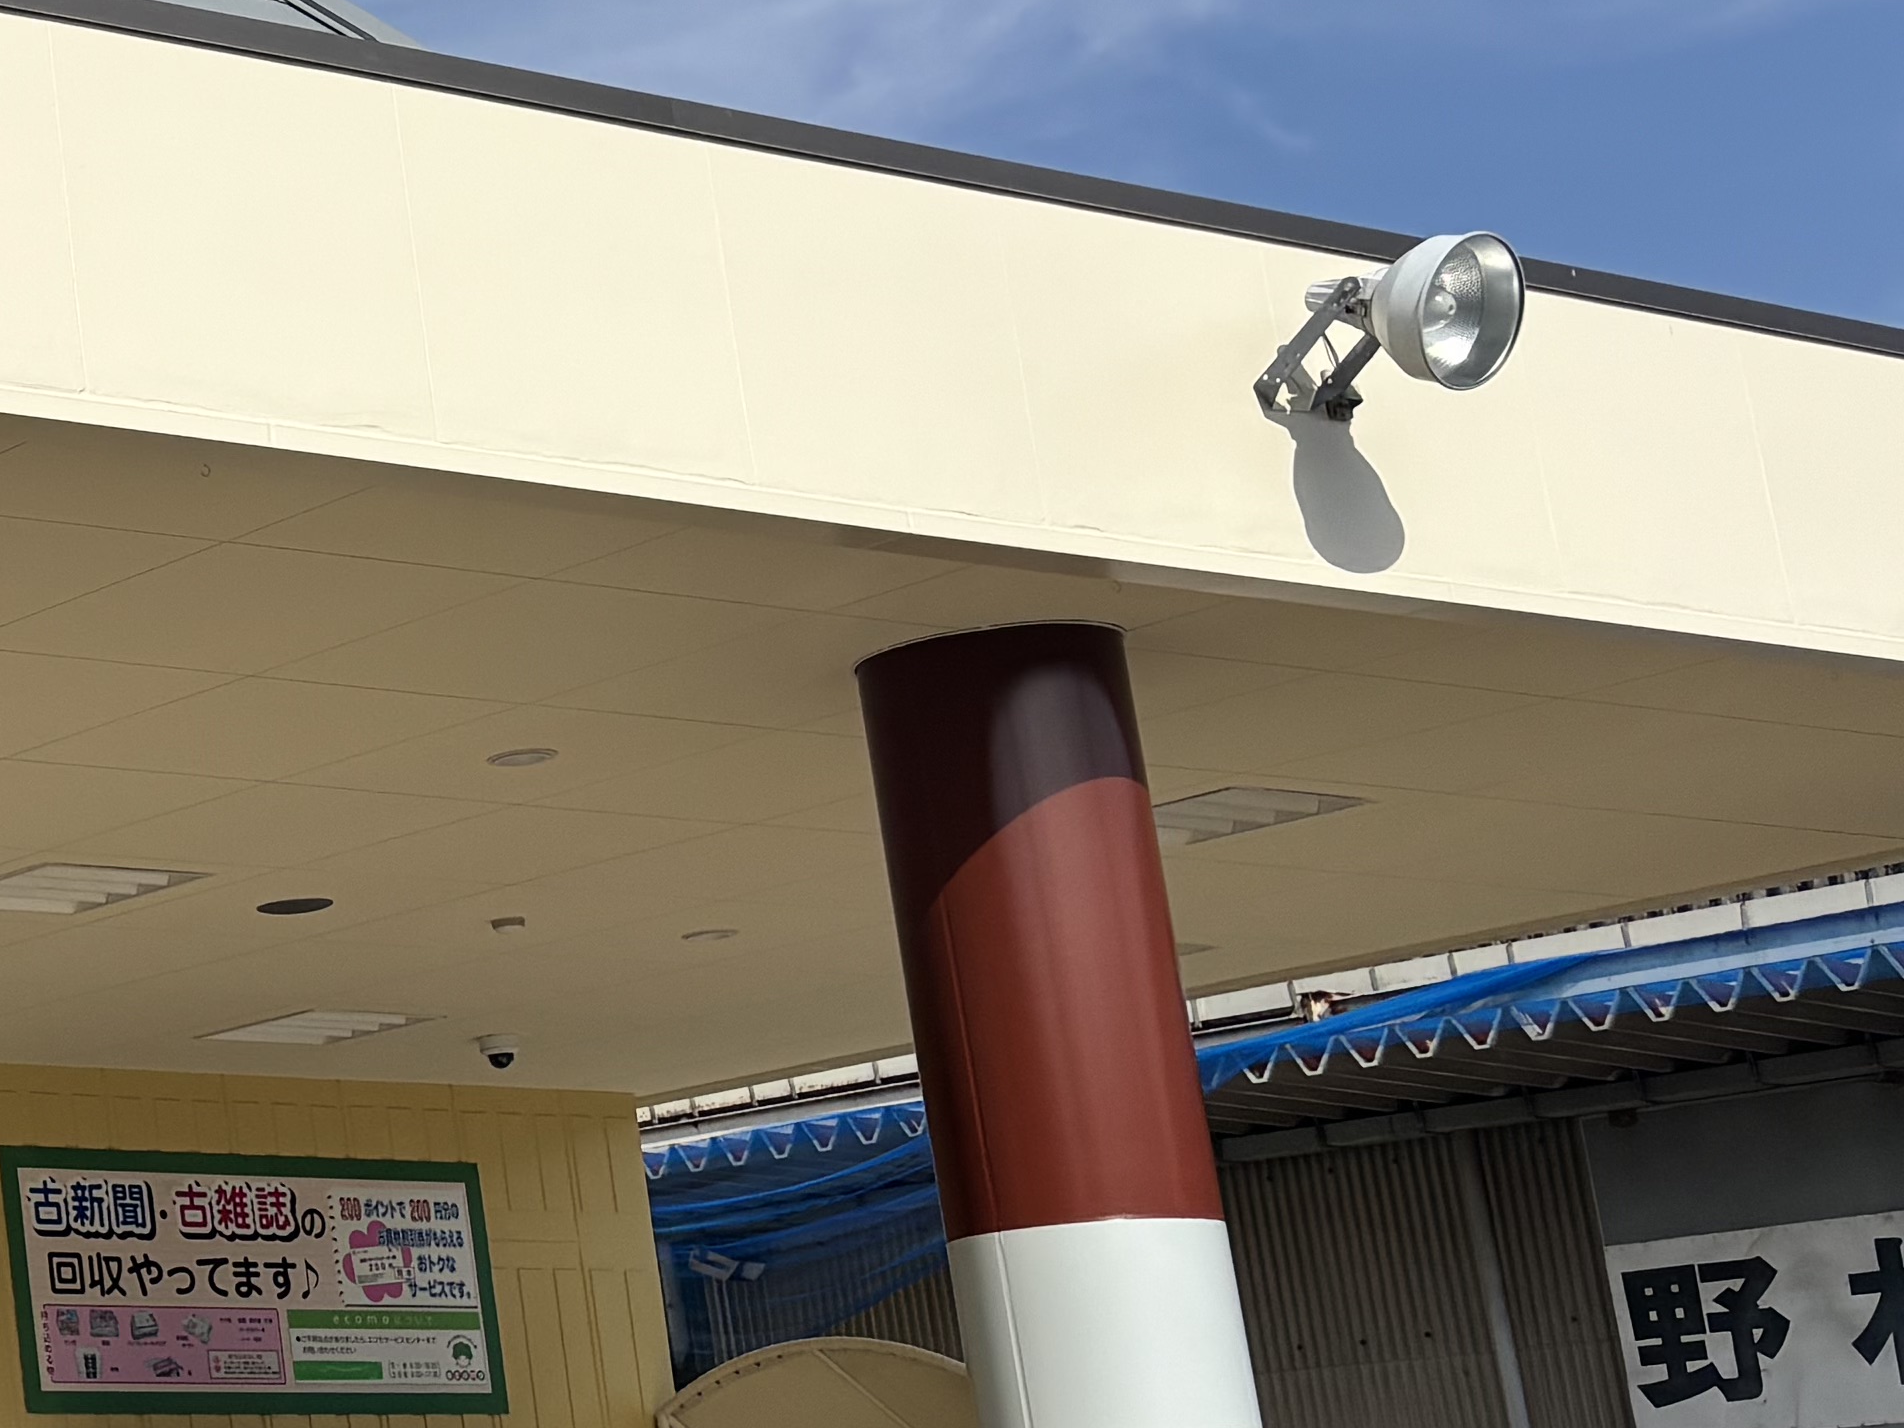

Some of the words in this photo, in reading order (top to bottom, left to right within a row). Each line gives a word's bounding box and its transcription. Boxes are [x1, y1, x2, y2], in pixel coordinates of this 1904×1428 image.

[27, 1177, 326, 1242] 古新聞・古雑誌の
[417, 1255, 456, 1273] おトクな
